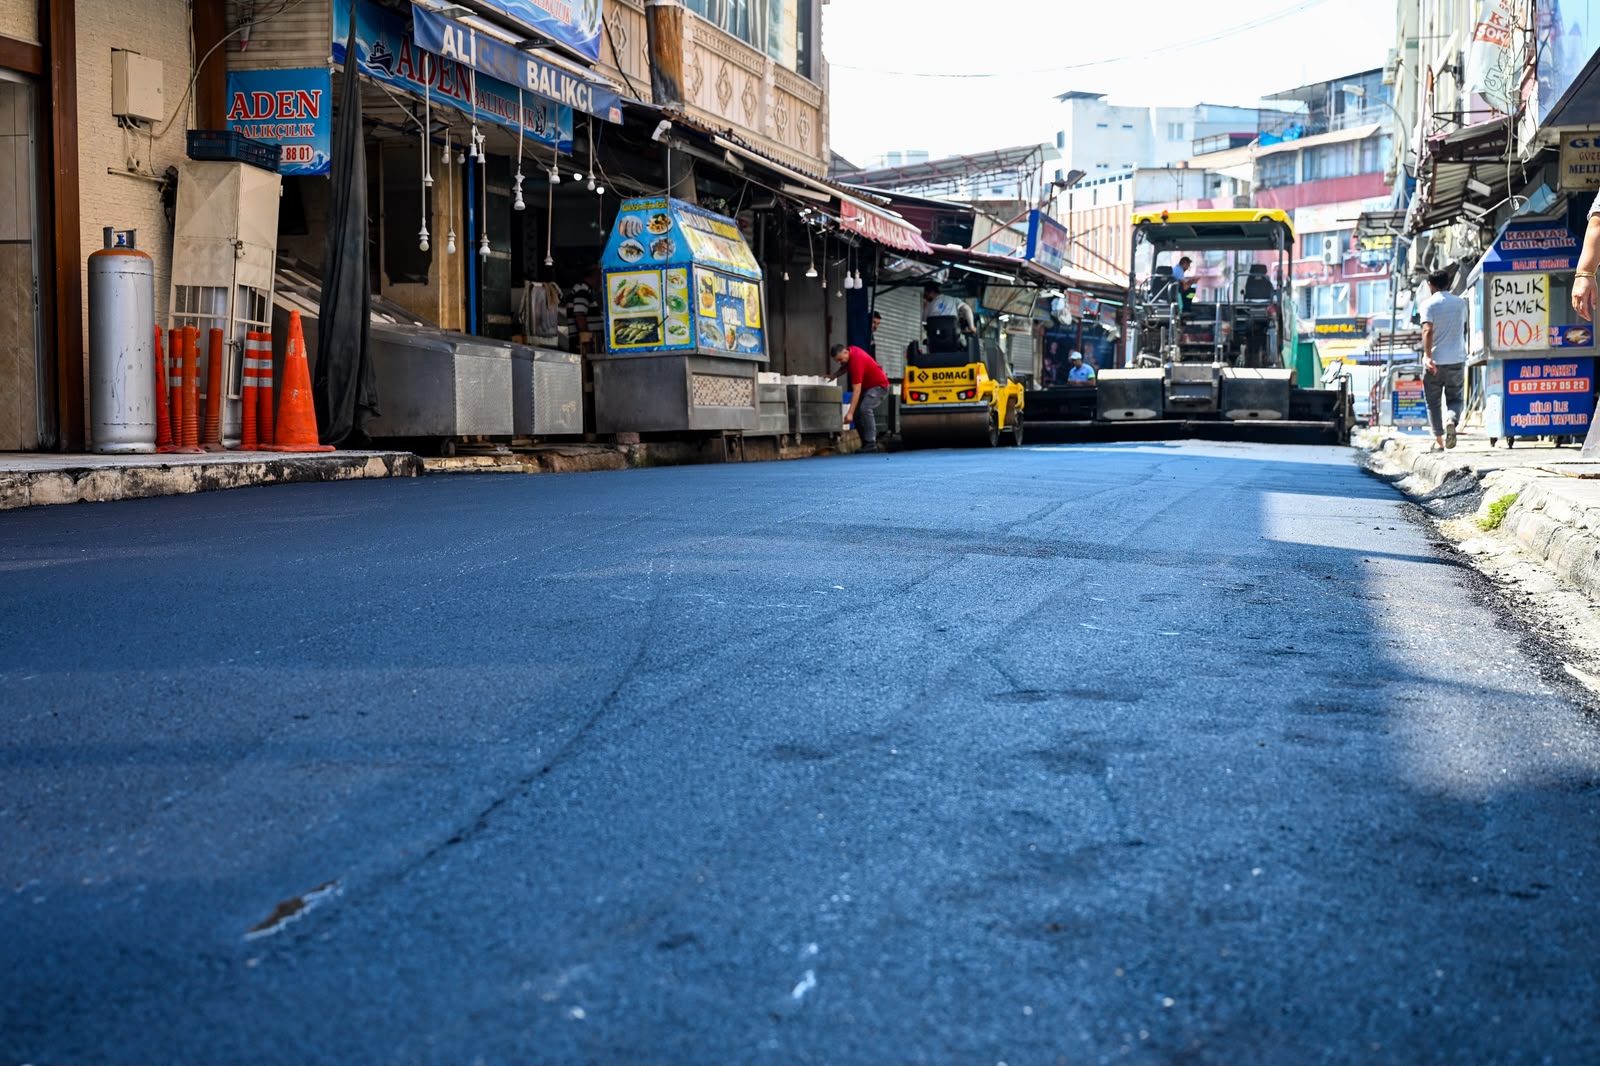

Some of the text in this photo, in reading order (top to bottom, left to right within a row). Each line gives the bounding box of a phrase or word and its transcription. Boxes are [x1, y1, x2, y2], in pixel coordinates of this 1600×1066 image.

[396, 36, 471, 104] ADEN
[226, 90, 322, 120] ADEN
[233, 123, 315, 140] BALIKÇILIK
[286, 147, 298, 160] 88
[299, 147, 310, 160] 01
[1495, 277, 1543, 297] BALIK
[1494, 297, 1546, 317] EKMEK
[932, 371, 967, 380] BOMAG
[1520, 364, 1578, 378] ALO PAKET
[1513, 383, 1519, 391] 0
[1573, 380, 1585, 389] 22
[1551, 413, 1588, 425] YAPILIR
